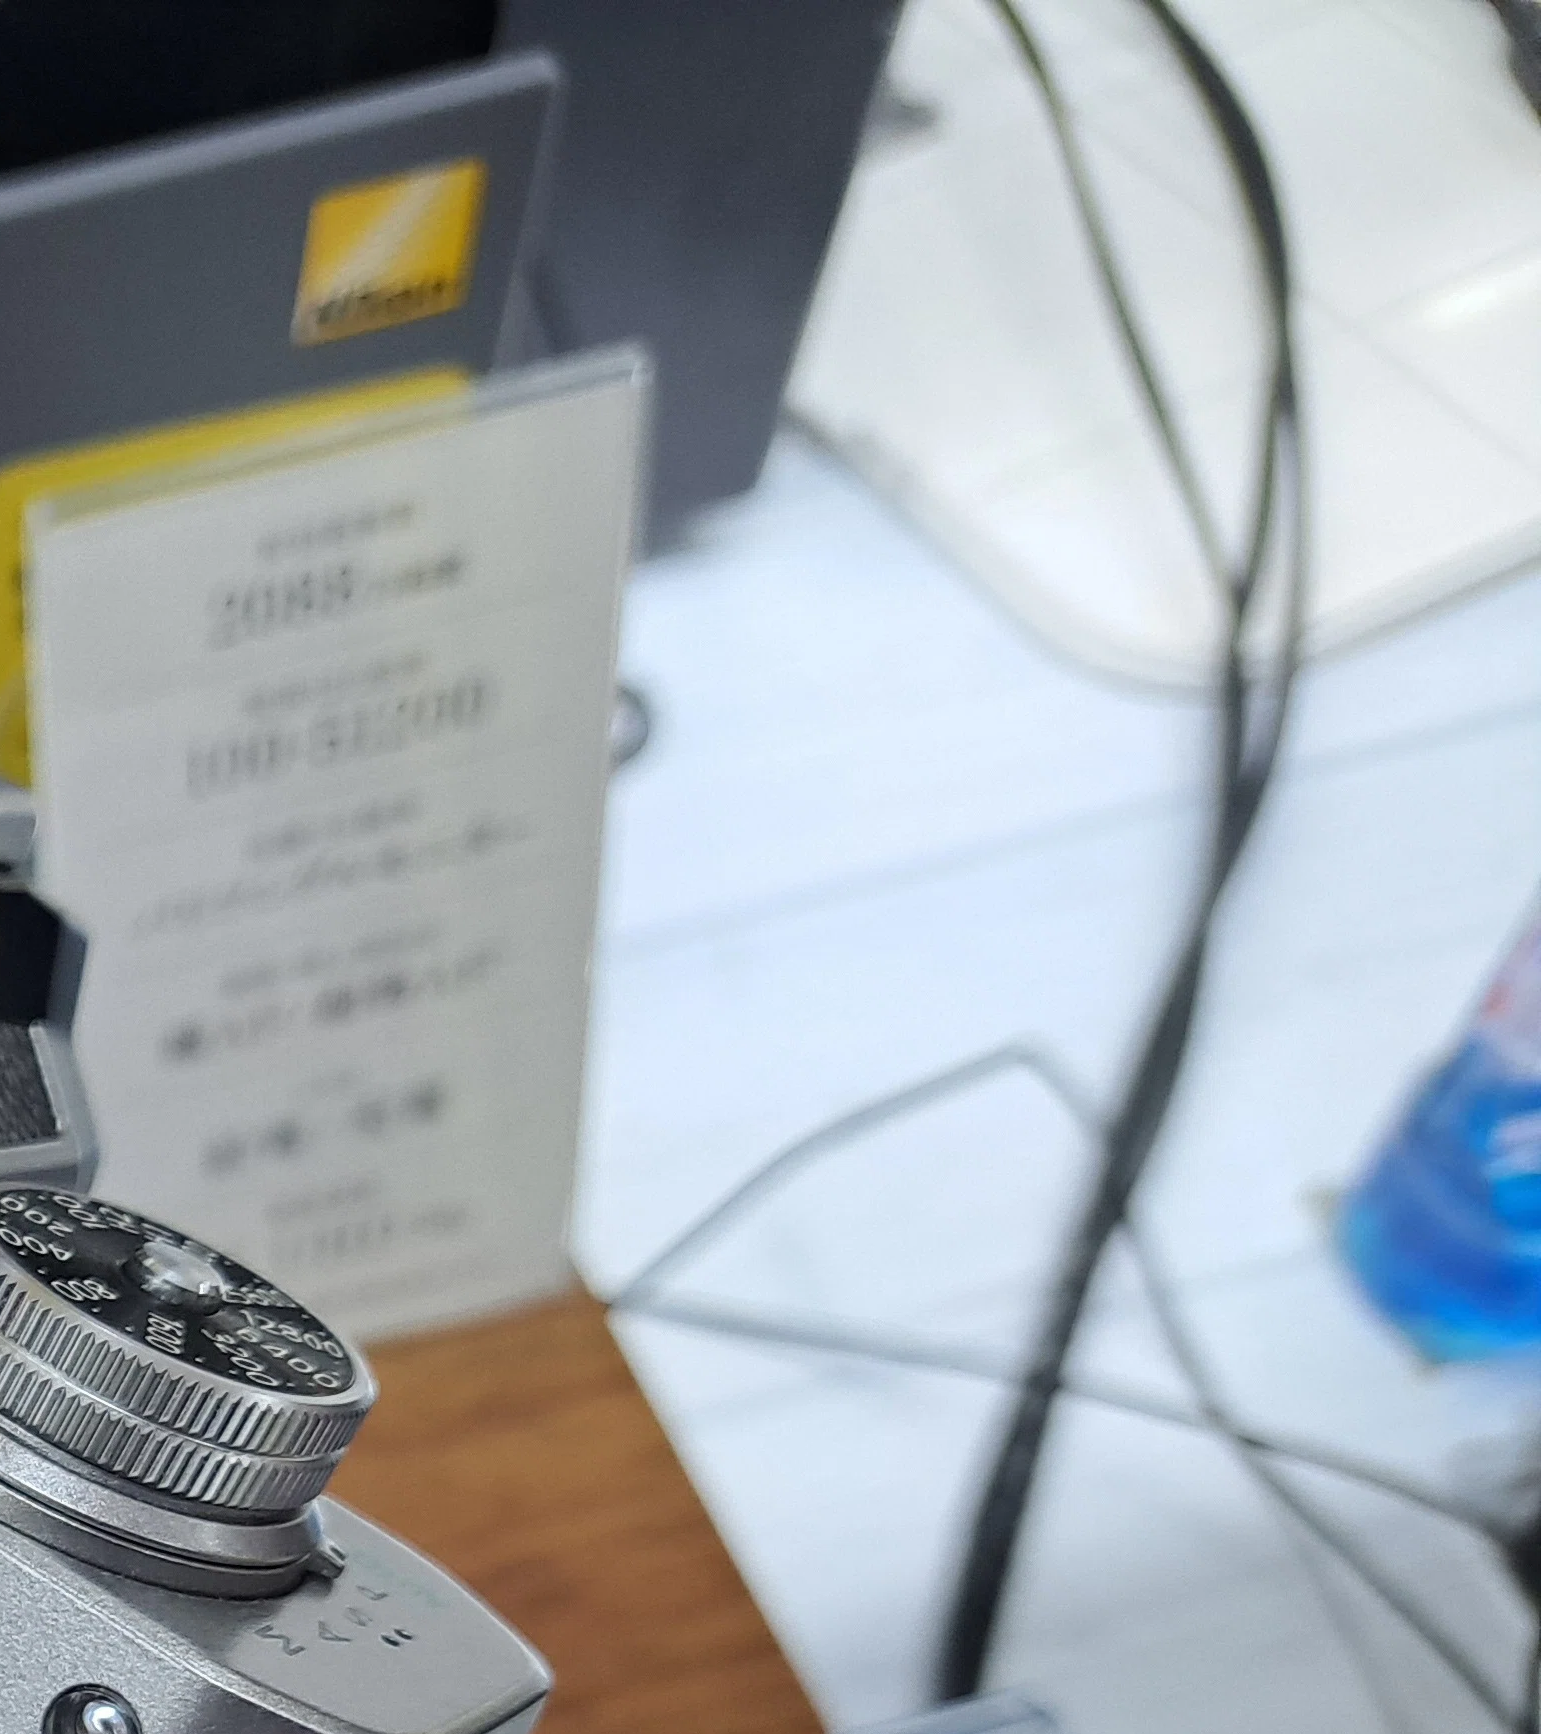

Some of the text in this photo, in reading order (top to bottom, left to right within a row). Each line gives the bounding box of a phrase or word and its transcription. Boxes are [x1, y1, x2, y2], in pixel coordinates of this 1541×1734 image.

[0, 1196, 73, 1237] 200
[53, 1195, 109, 1229] 100
[51, 1279, 118, 1301] 800
[145, 1312, 185, 1355] 1600
[236, 1328, 340, 1388] 6400
